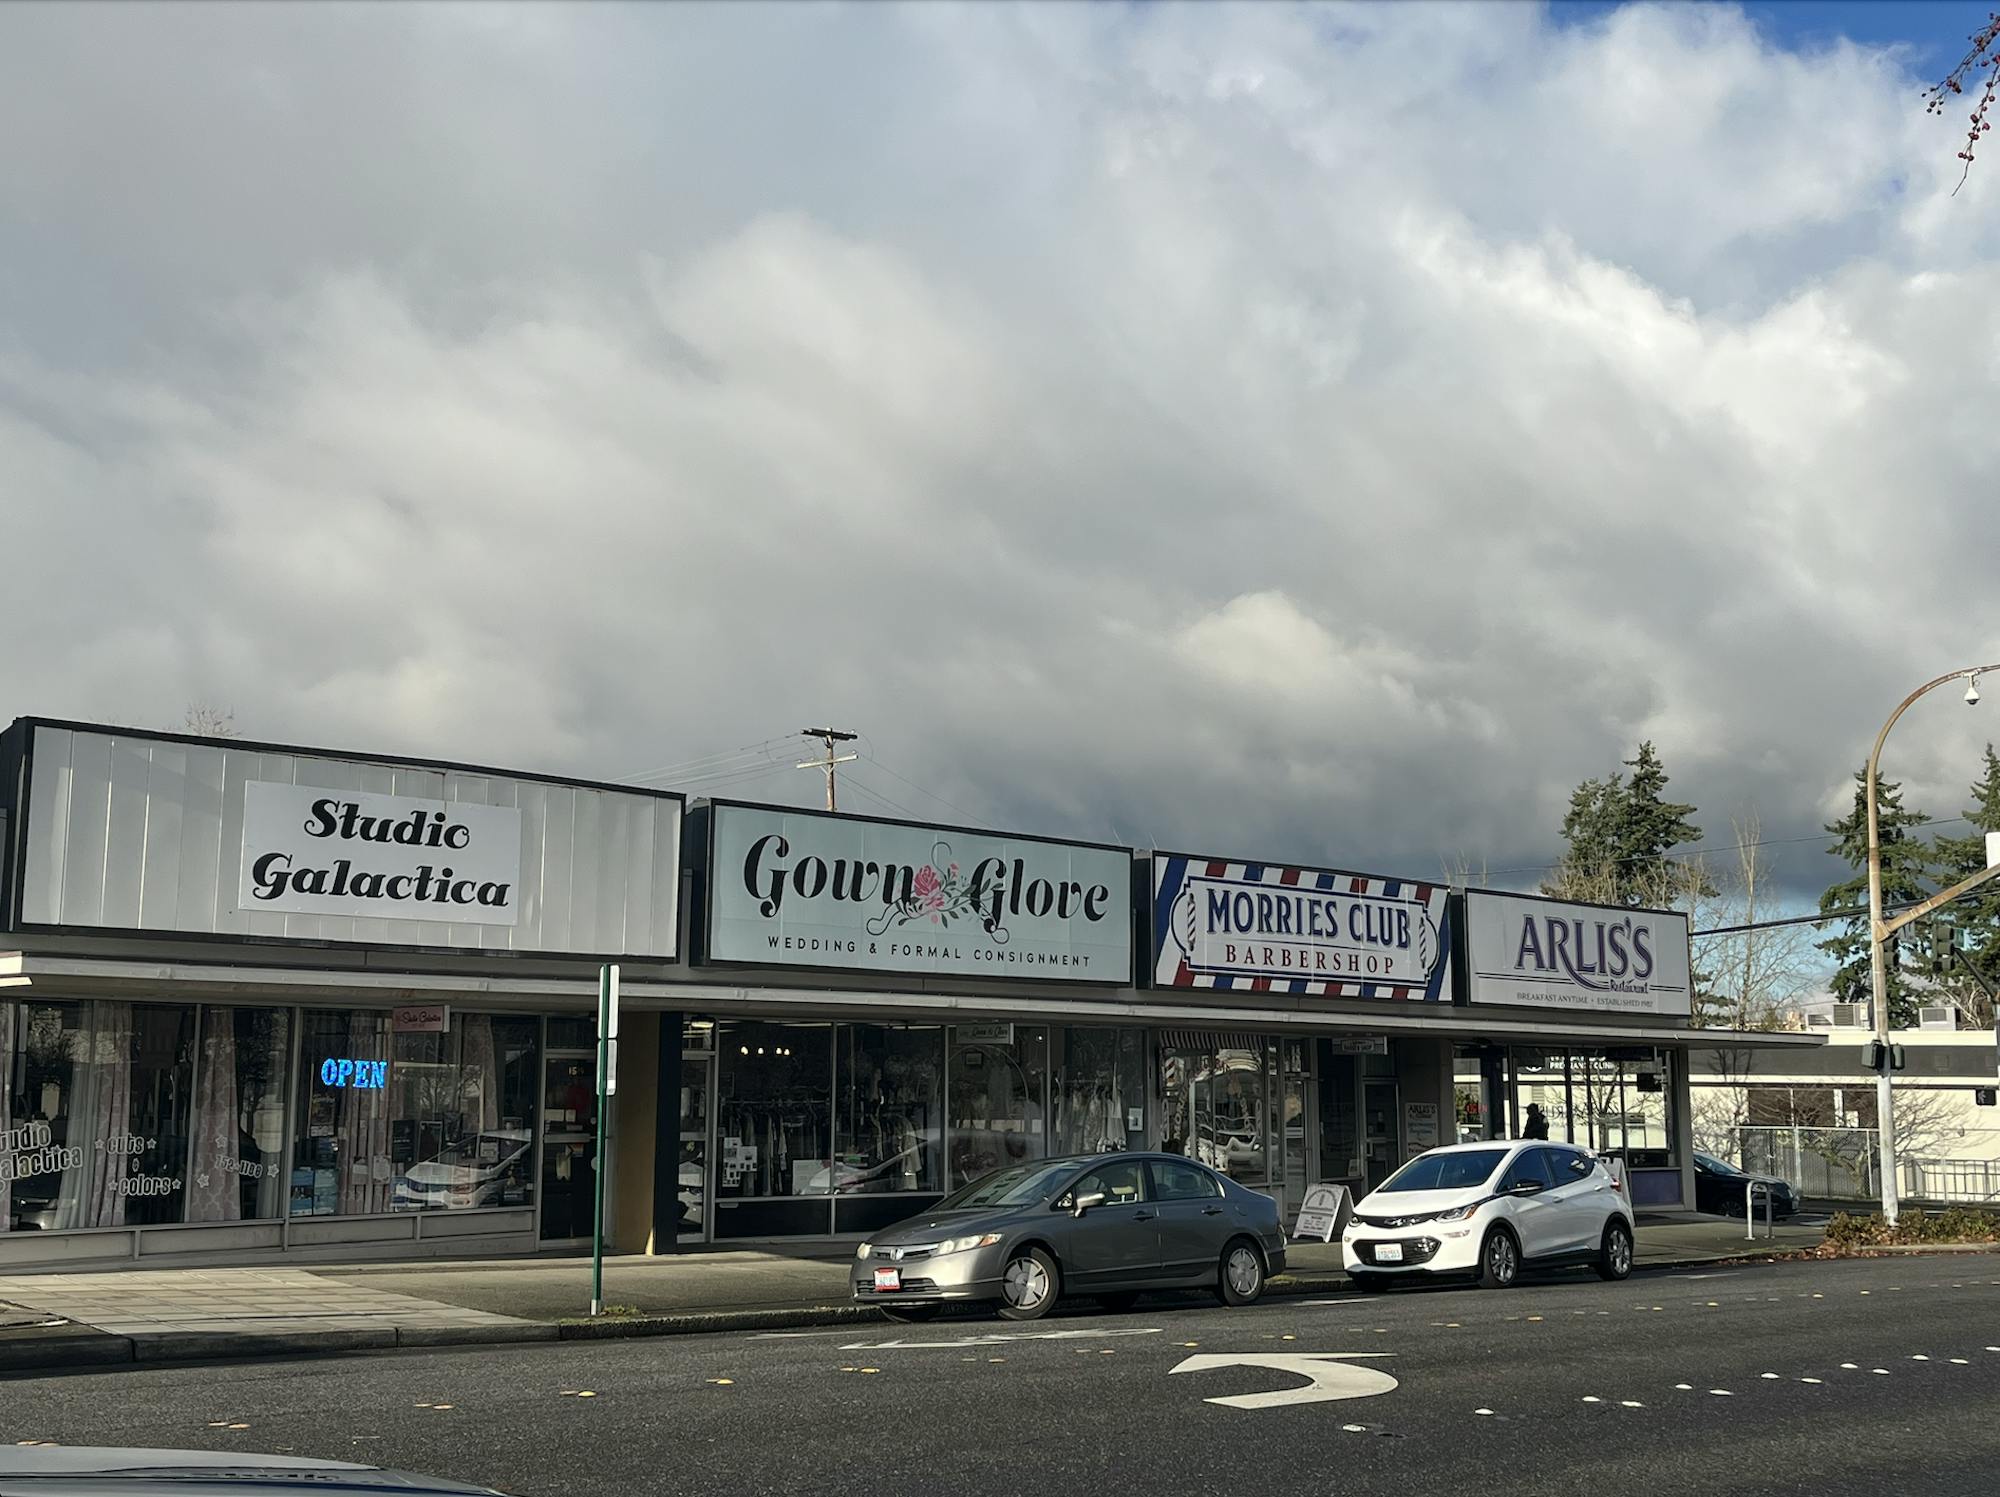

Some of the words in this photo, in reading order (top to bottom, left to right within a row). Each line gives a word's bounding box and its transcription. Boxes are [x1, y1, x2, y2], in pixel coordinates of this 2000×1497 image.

[304, 799, 470, 849] Studio
[252, 852, 511, 907] Galactica
[743, 834, 913, 934] Gown
[968, 856, 1109, 943] Glove
[1206, 888, 1339, 938] MORRIES
[1348, 903, 1411, 949] CLUB
[768, 936, 856, 953] WEDDING
[869, 943, 877, 954] &
[891, 943, 961, 959] FORMAL
[974, 949, 1091, 967] CONSIGNMENT
[1226, 944, 1395, 974] BARBERSHOP
[1513, 913, 1653, 986] ARLIS'S
[321, 1058, 388, 1089] OPEN
[0, 1121, 52, 1154] tudio
[107, 1132, 145, 1155] cuts
[0, 1144, 83, 1183] alactica
[119, 1173, 171, 1196] colors
